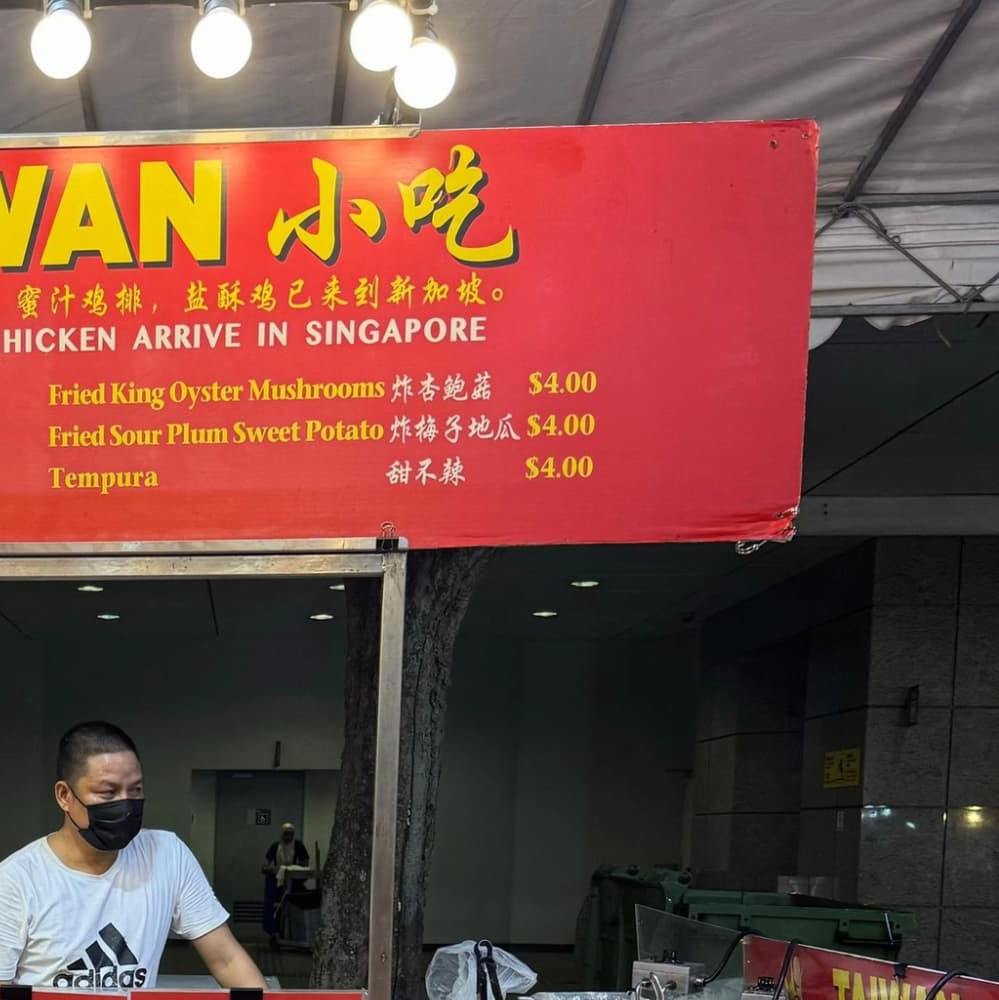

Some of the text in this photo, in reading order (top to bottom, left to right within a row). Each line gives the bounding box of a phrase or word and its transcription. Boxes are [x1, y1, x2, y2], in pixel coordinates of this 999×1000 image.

[267, 143, 518, 267] 小吃
[132, 322, 241, 350] ARRIVE
[257, 321, 288, 347] IN
[305, 316, 488, 346] SINGAPORE
[48, 377, 386, 411] Fried King Oyster Mushrooms
[390, 371, 492, 404] 炸杏鲍菇
[528, 370, 598, 396] $4.00
[48, 418, 385, 448] Fried Sour Plum Sweet Potato
[389, 413, 521, 445] 炸梅子地瓜
[526, 412, 596, 438] $4.00
[47, 466, 159, 495] Tempura
[385, 455, 466, 487] 甜不辣
[525, 454, 594, 480] $4.00
[53, 966, 147, 988] adidas
